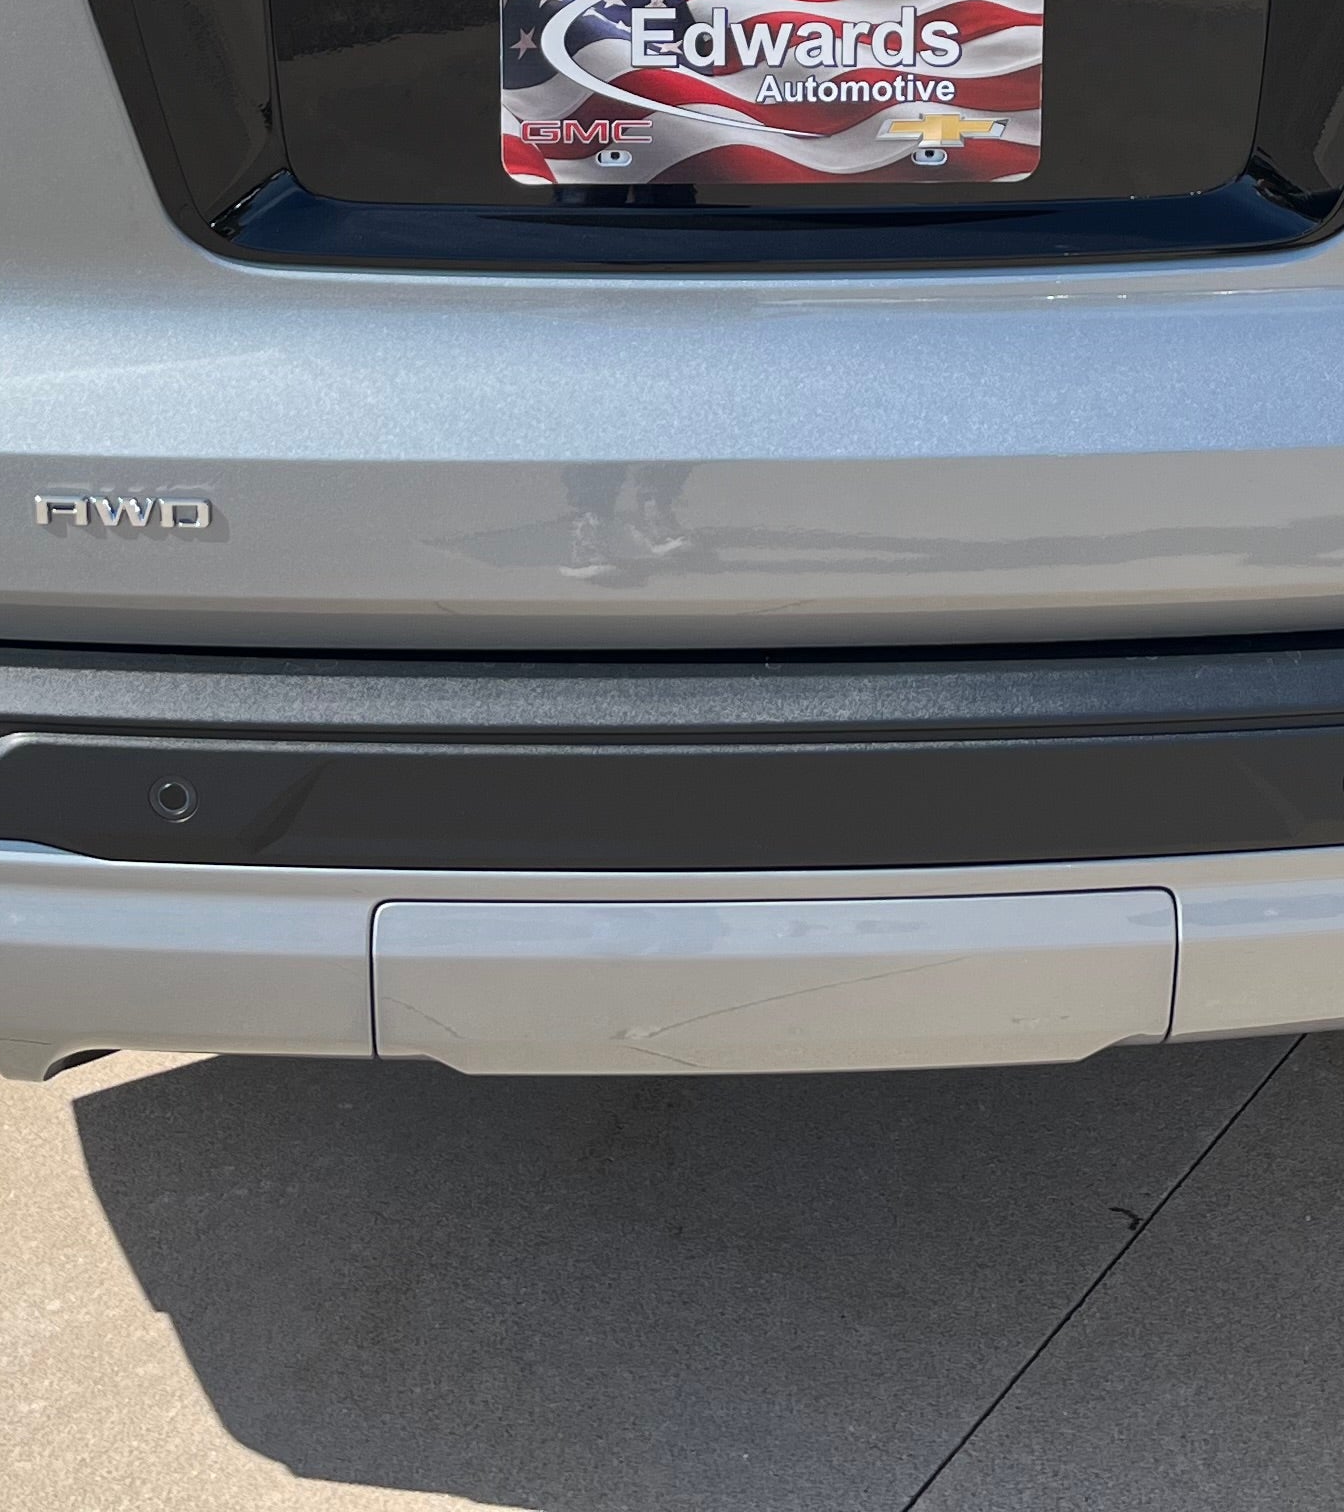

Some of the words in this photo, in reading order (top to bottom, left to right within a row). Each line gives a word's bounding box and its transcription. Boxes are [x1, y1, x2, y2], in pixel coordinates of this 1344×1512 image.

[631, 6, 962, 68] Edwards
[756, 74, 955, 102] Automotive
[520, 120, 653, 144] GMC
[34, 495, 212, 528] AWD
